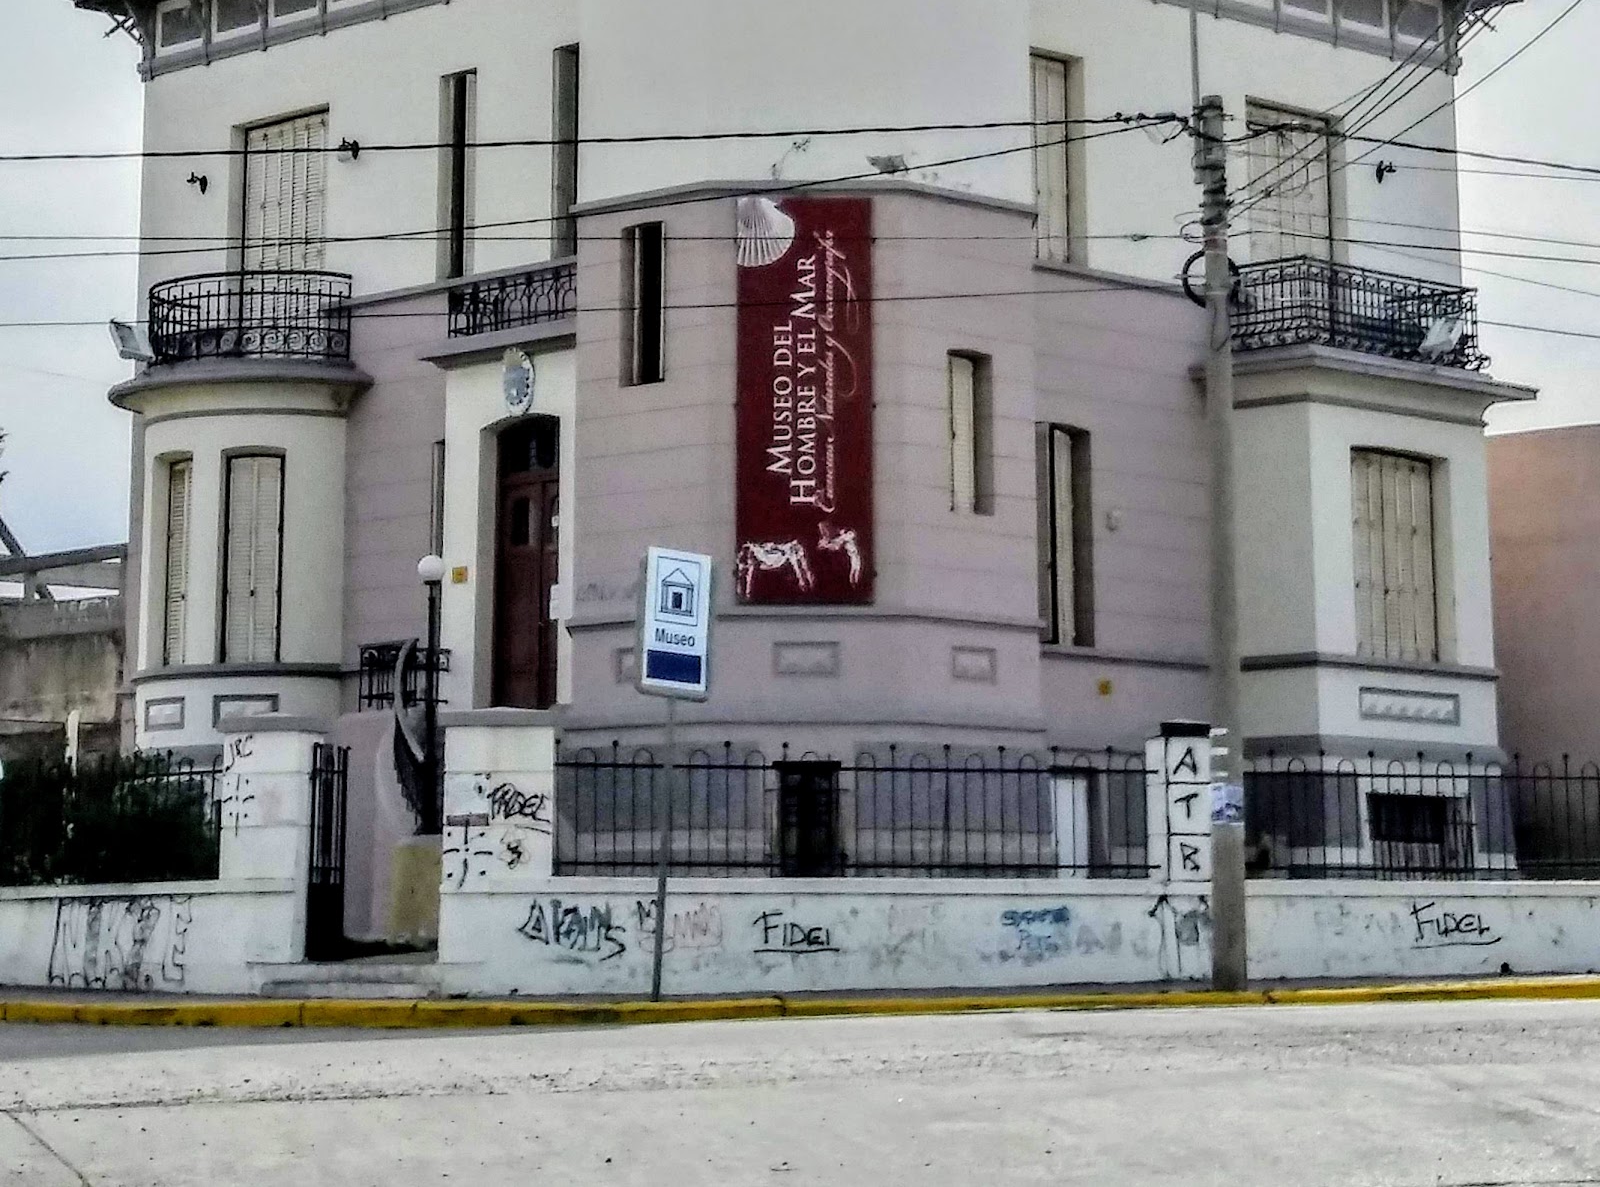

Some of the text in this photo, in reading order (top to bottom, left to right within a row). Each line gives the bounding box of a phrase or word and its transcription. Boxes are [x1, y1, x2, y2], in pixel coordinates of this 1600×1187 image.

[766, 320, 792, 475] MUSEO DEL
[790, 254, 816, 505] HOMBRE Y EL MAR
[655, 628, 696, 647] Museo
